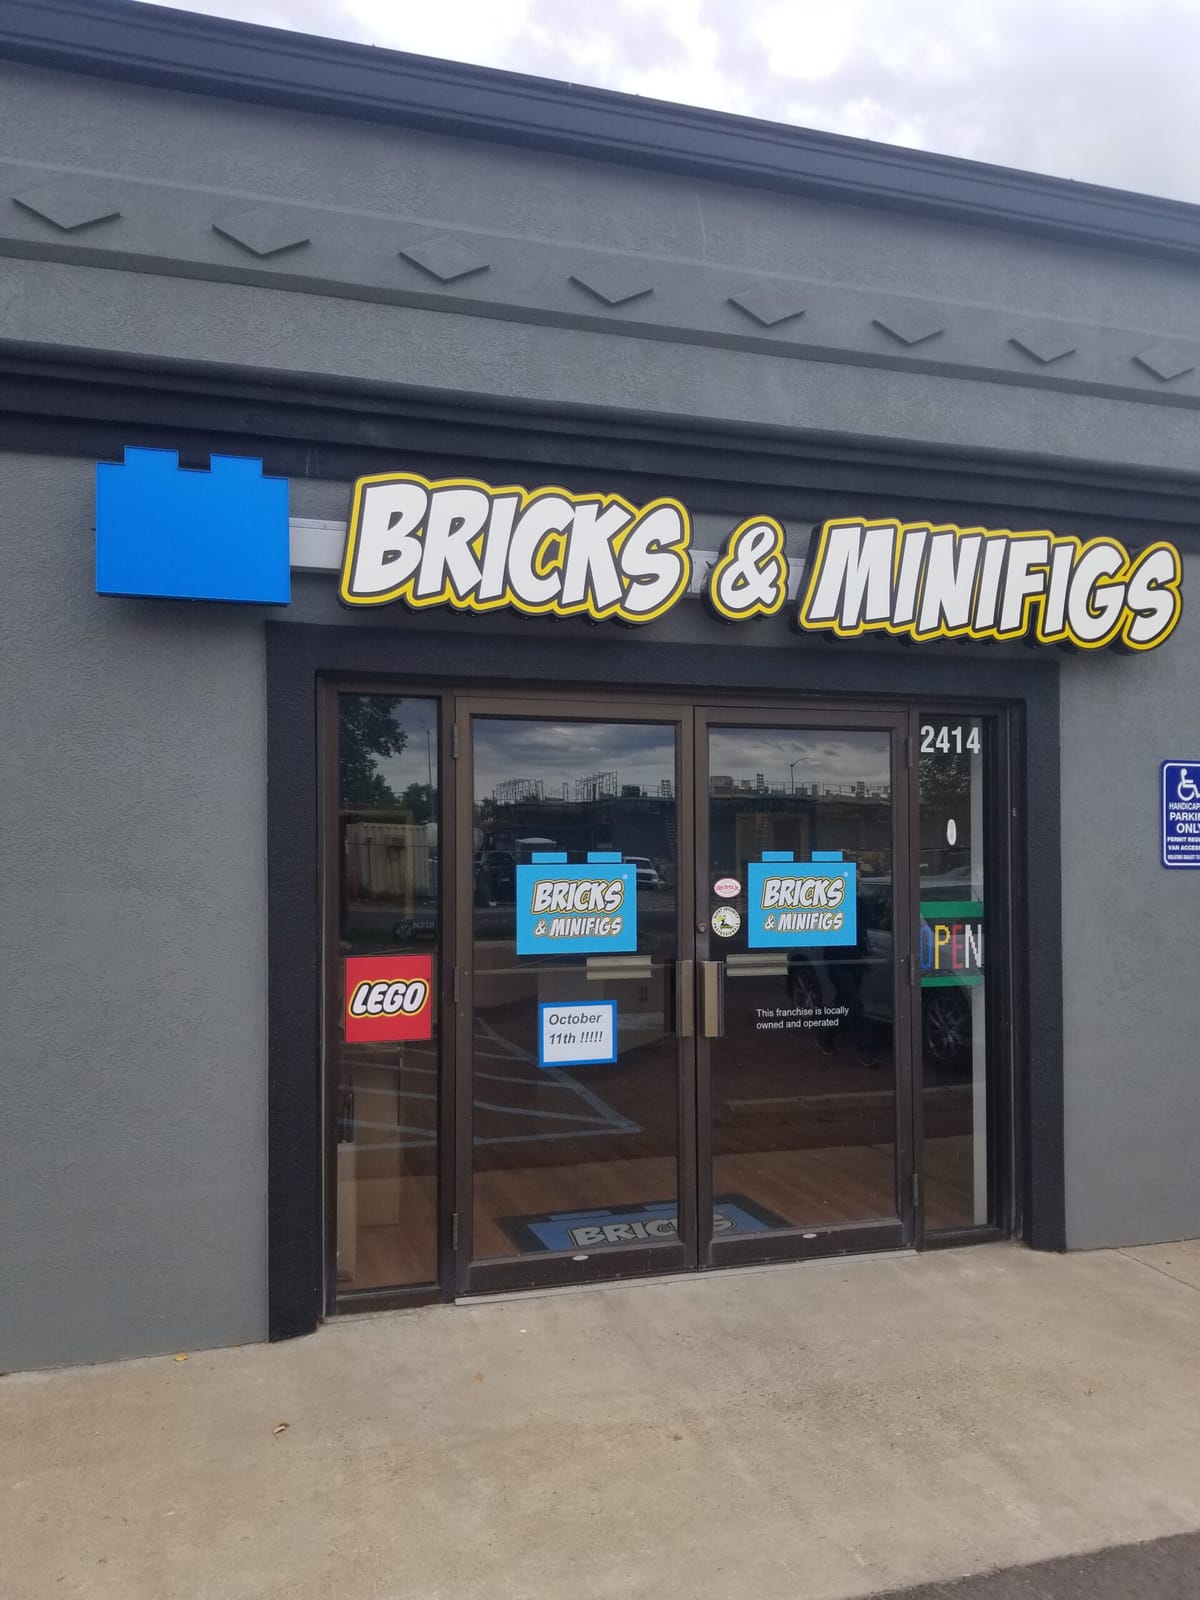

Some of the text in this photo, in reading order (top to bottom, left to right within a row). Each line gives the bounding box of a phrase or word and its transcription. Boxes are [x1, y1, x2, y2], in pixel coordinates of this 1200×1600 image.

[346, 478, 1180, 648] BRICKS & MINIFIGS
[920, 725, 981, 754] 2414
[531, 880, 624, 913] BRICKS
[762, 877, 845, 909] BRICKS
[535, 916, 623, 937] & MINIFIGS
[764, 912, 843, 932] & MINIFIGS
[920, 924, 982, 970] OPEN
[350, 980, 428, 1016] LEGO
[756, 1005, 849, 1018] This franchise is locally
[549, 1013, 602, 1025] October
[756, 1018, 839, 1030] owned and operated
[549, 1032, 576, 1045] 11th
[571, 1213, 734, 1247] BRICS
